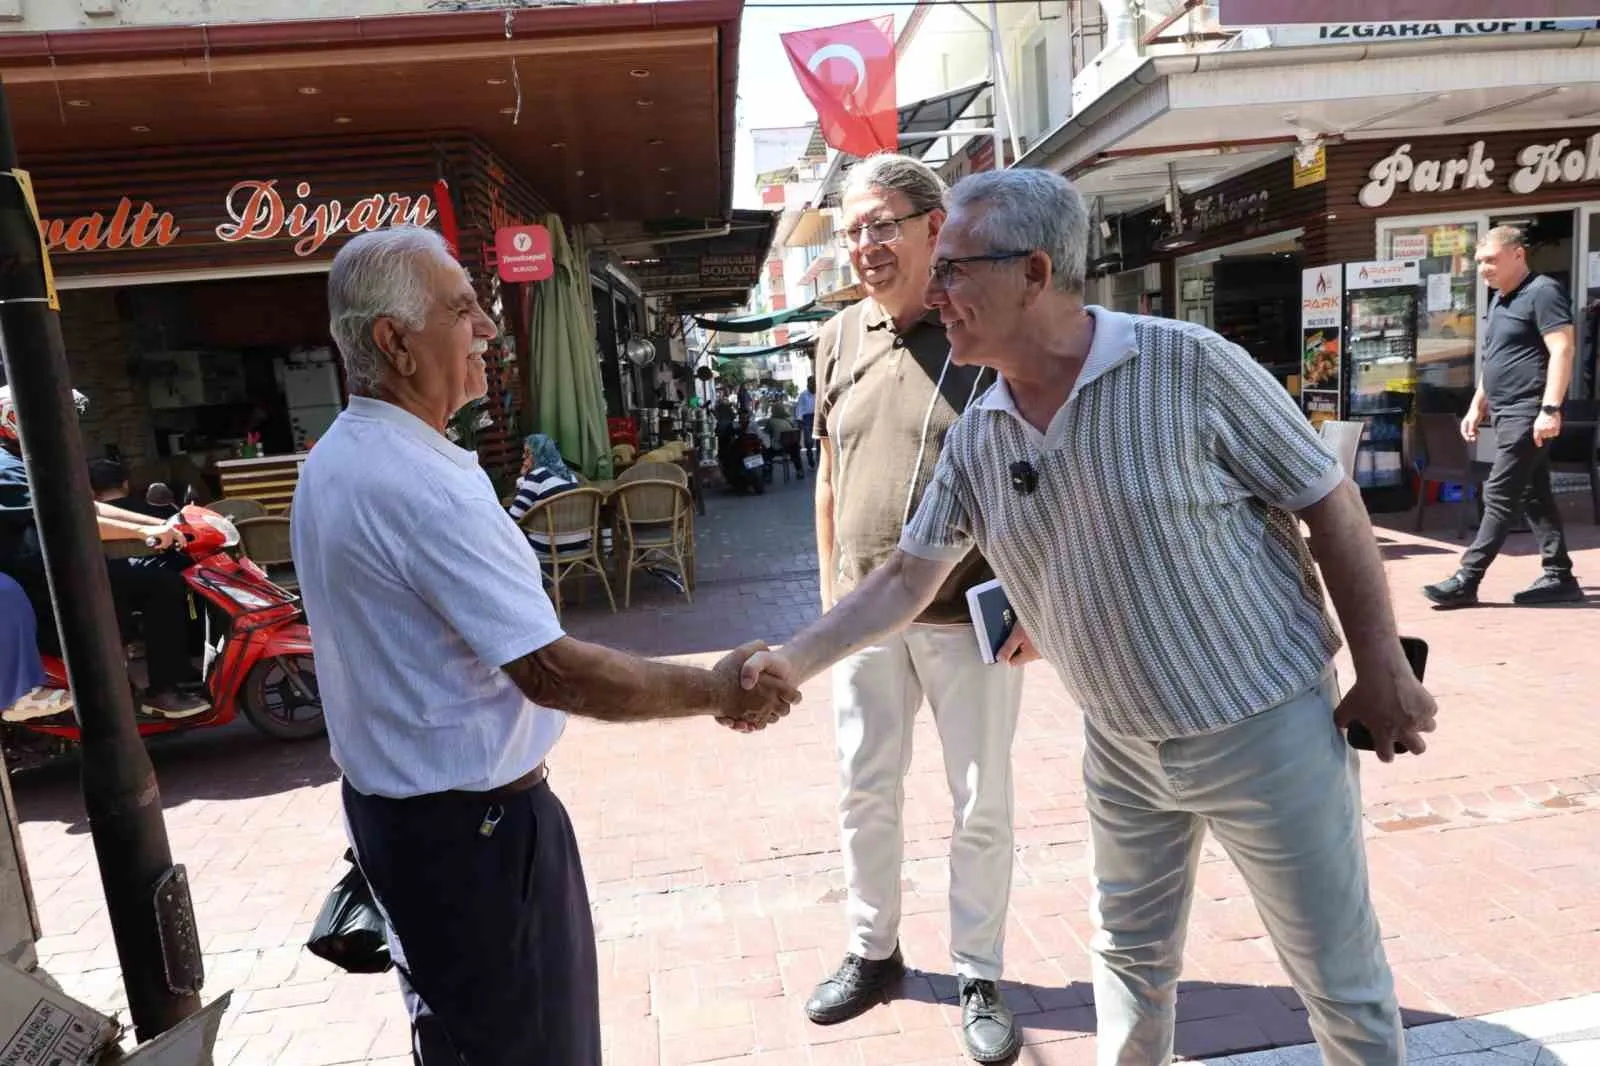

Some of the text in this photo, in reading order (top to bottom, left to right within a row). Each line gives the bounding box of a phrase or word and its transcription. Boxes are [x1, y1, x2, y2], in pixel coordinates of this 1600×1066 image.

[1358, 139, 1496, 208] Park
[38, 196, 181, 252] valtı
[214, 179, 438, 257] Diyarı
[1303, 296, 1339, 310] PARK
